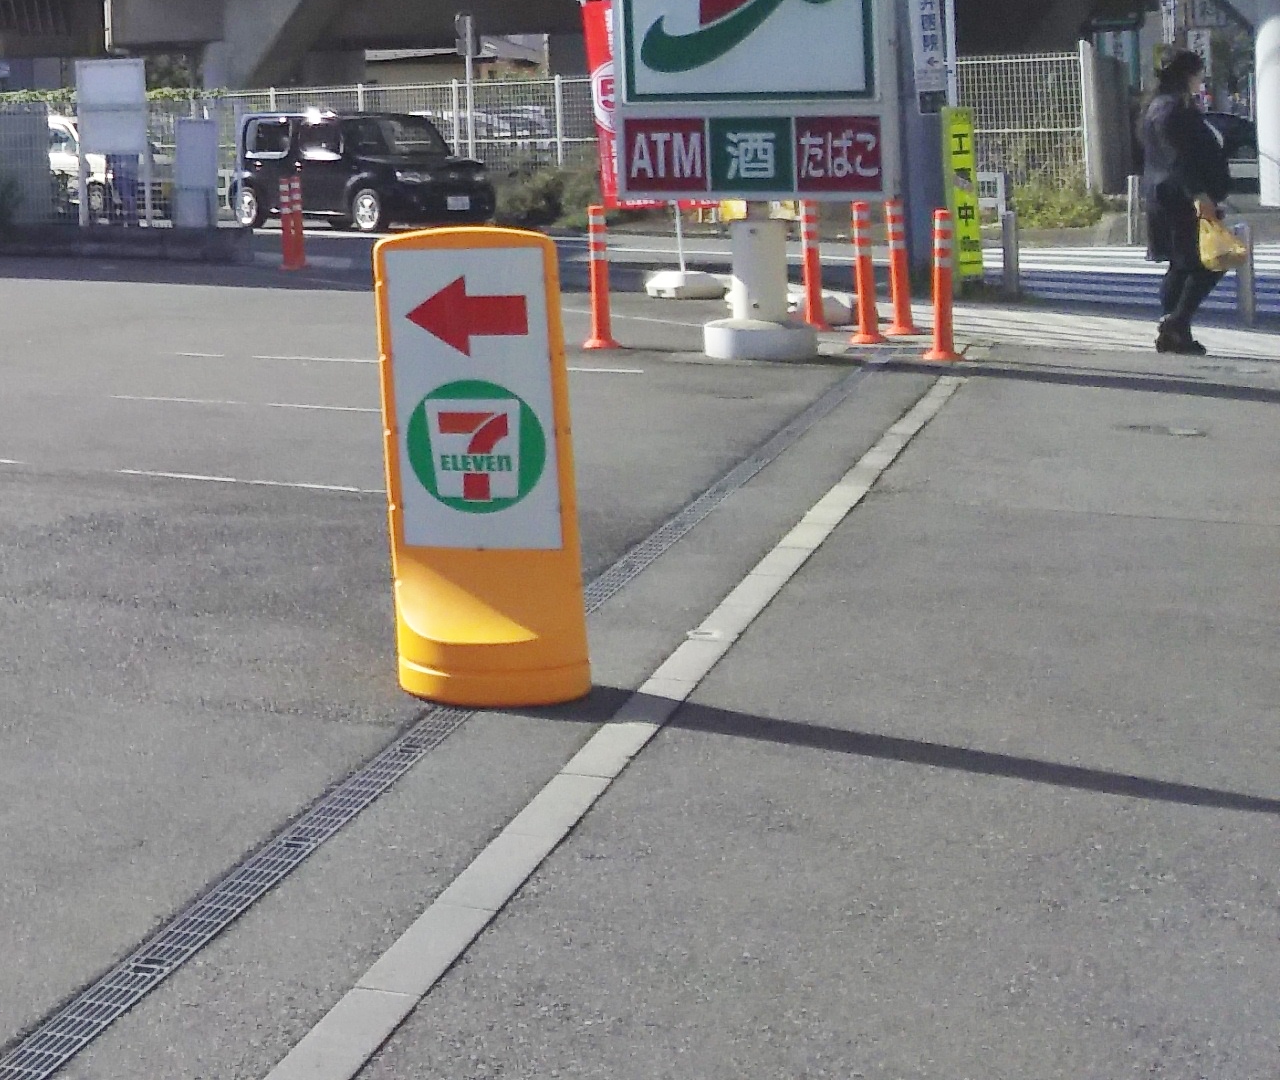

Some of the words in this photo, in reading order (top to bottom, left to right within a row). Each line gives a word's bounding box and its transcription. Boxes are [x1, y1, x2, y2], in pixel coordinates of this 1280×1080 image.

[630, 132, 702, 179] ATM
[726, 131, 776, 180] 酒
[800, 130, 879, 178] たばこ
[438, 412, 508, 500] 7
